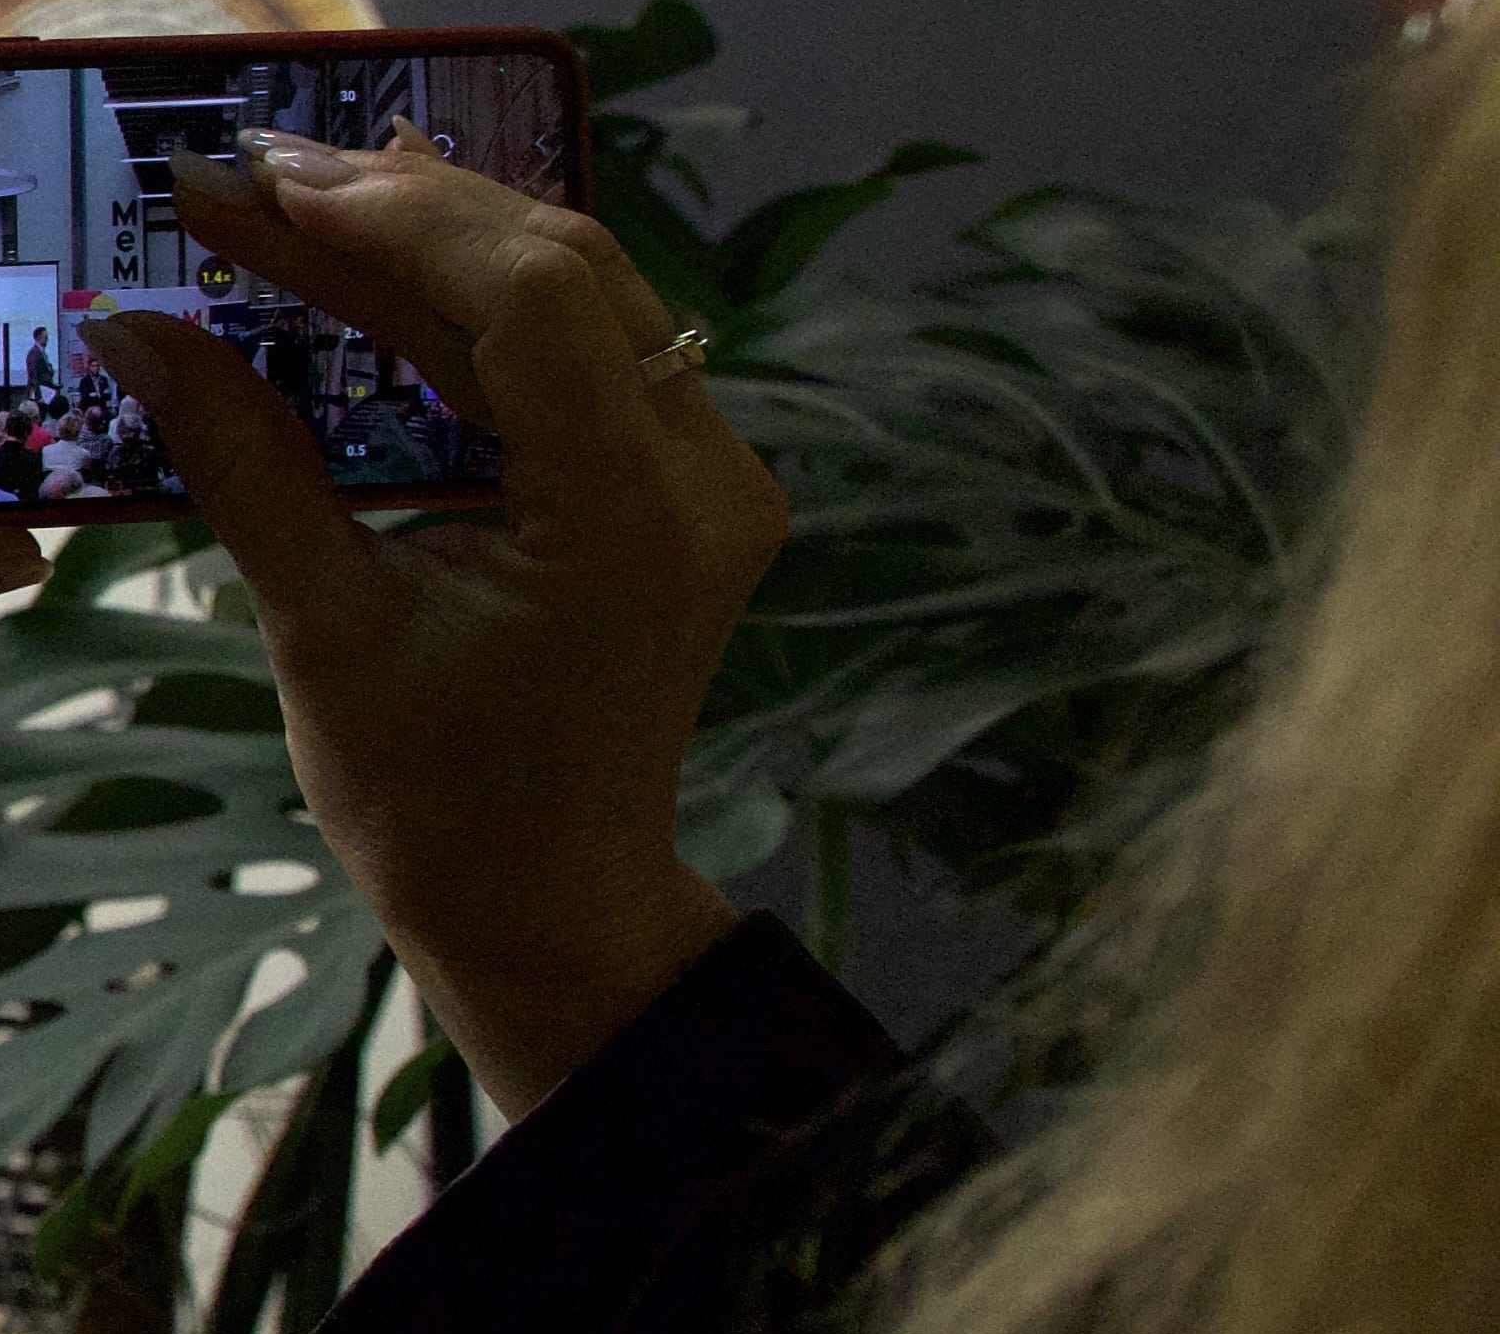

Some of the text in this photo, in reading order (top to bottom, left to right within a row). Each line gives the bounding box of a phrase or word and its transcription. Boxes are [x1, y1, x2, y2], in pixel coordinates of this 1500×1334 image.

[340, 90, 356, 102] 30
[111, 199, 139, 290] MeM
[348, 386, 366, 397] 1.0
[346, 444, 366, 457] 0.5
